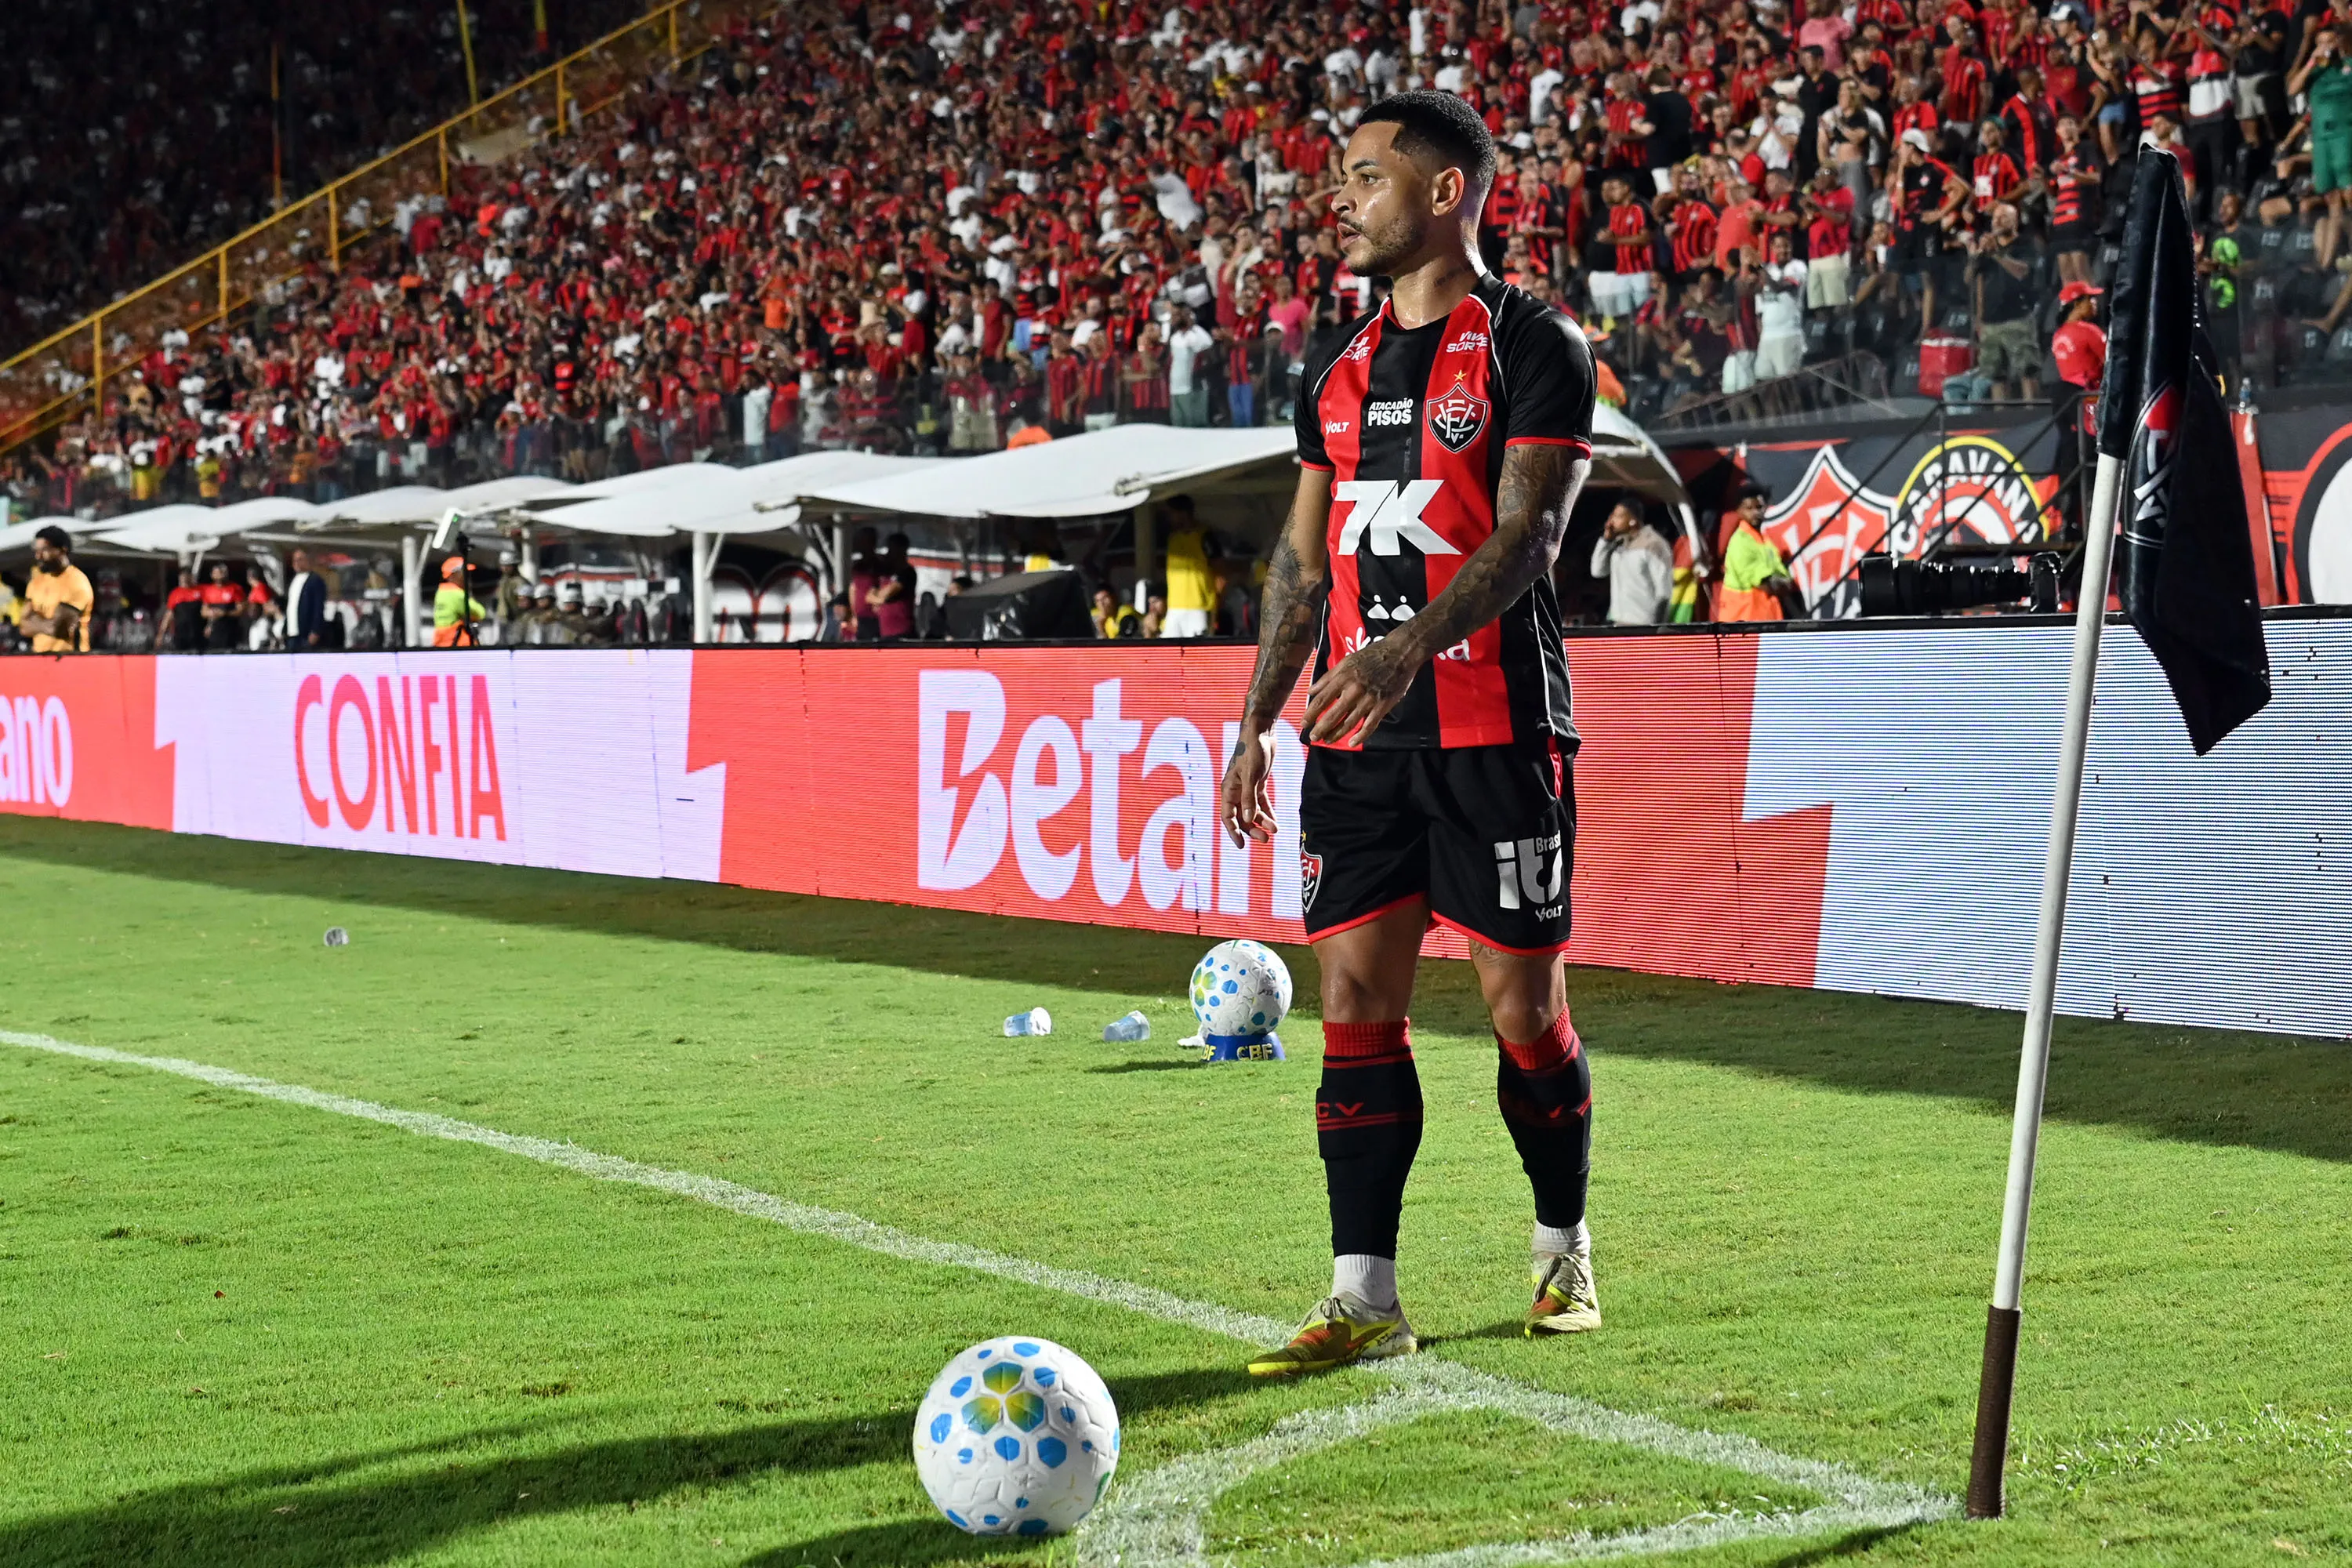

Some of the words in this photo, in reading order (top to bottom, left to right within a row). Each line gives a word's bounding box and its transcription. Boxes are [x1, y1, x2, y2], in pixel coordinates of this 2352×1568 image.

[1342, 346, 1371, 361] ORTE
[1446, 337, 1488, 353] SORE
[1369, 397, 1414, 411] ATACADÃO
[1367, 408, 1412, 426] PISOS
[1325, 421, 1349, 435] VOLT
[1334, 479, 1463, 556] 7K
[294, 673, 506, 841] CONFIA
[918, 669, 1304, 920] Betan
[1535, 829, 1562, 854] Brasl
[1535, 905, 1563, 923] VOLT
[1236, 1043, 1273, 1062] CBF
